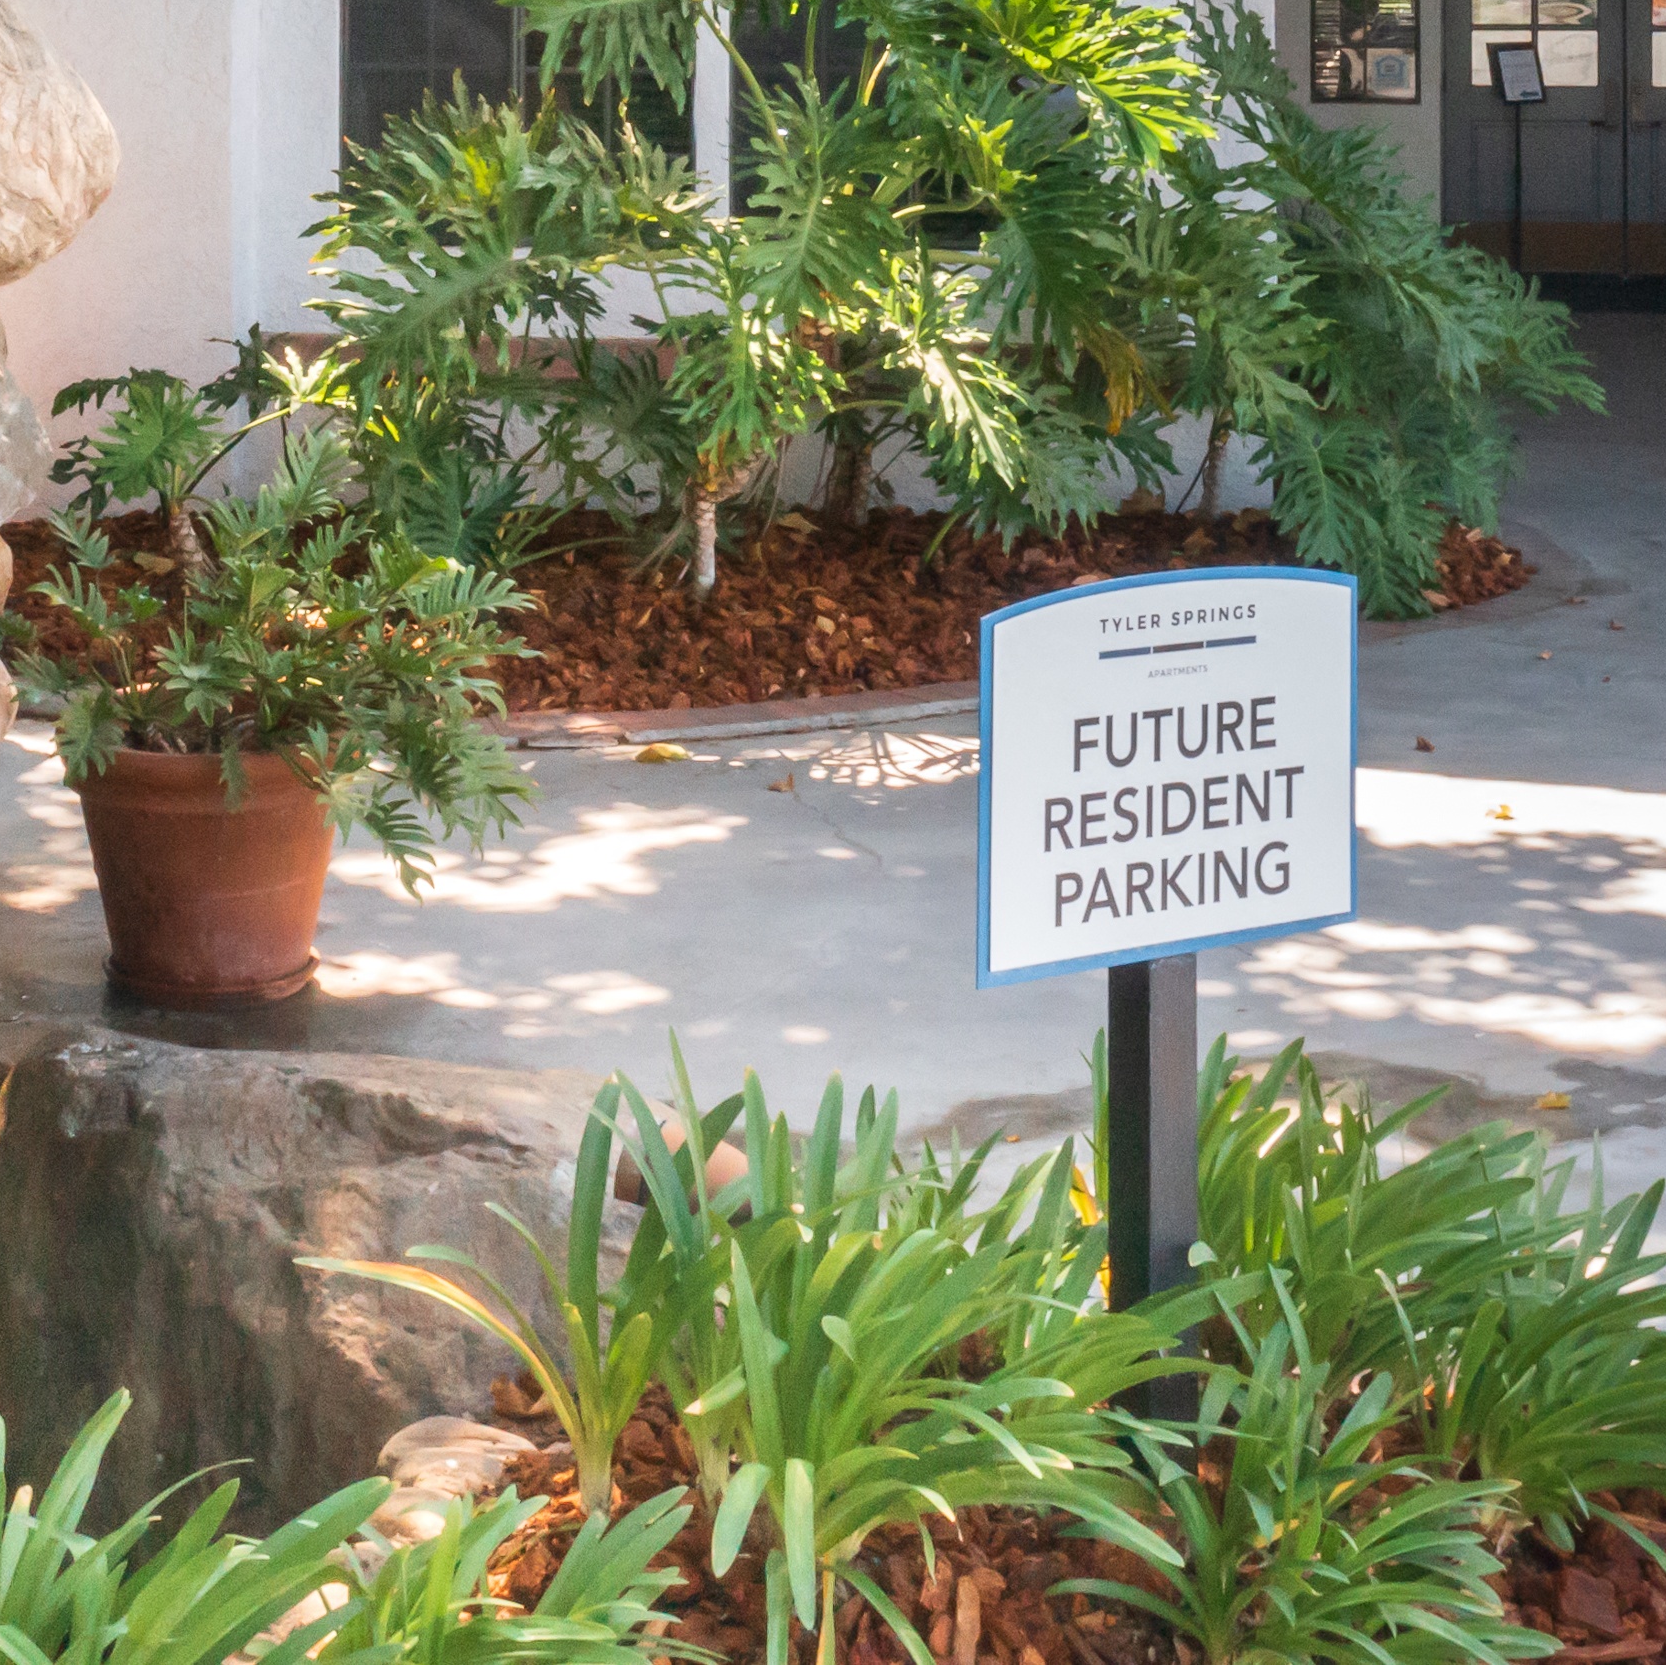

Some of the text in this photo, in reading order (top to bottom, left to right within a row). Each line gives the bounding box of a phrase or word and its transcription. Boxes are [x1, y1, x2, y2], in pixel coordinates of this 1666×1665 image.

[1100, 604, 1256, 634] TYLER SPRINGS
[1148, 664, 1208, 679] APARTMENTS
[1073, 695, 1277, 773] FUTURE
[1044, 765, 1305, 852] RESIDENT
[1055, 841, 1290, 927] PARKING
